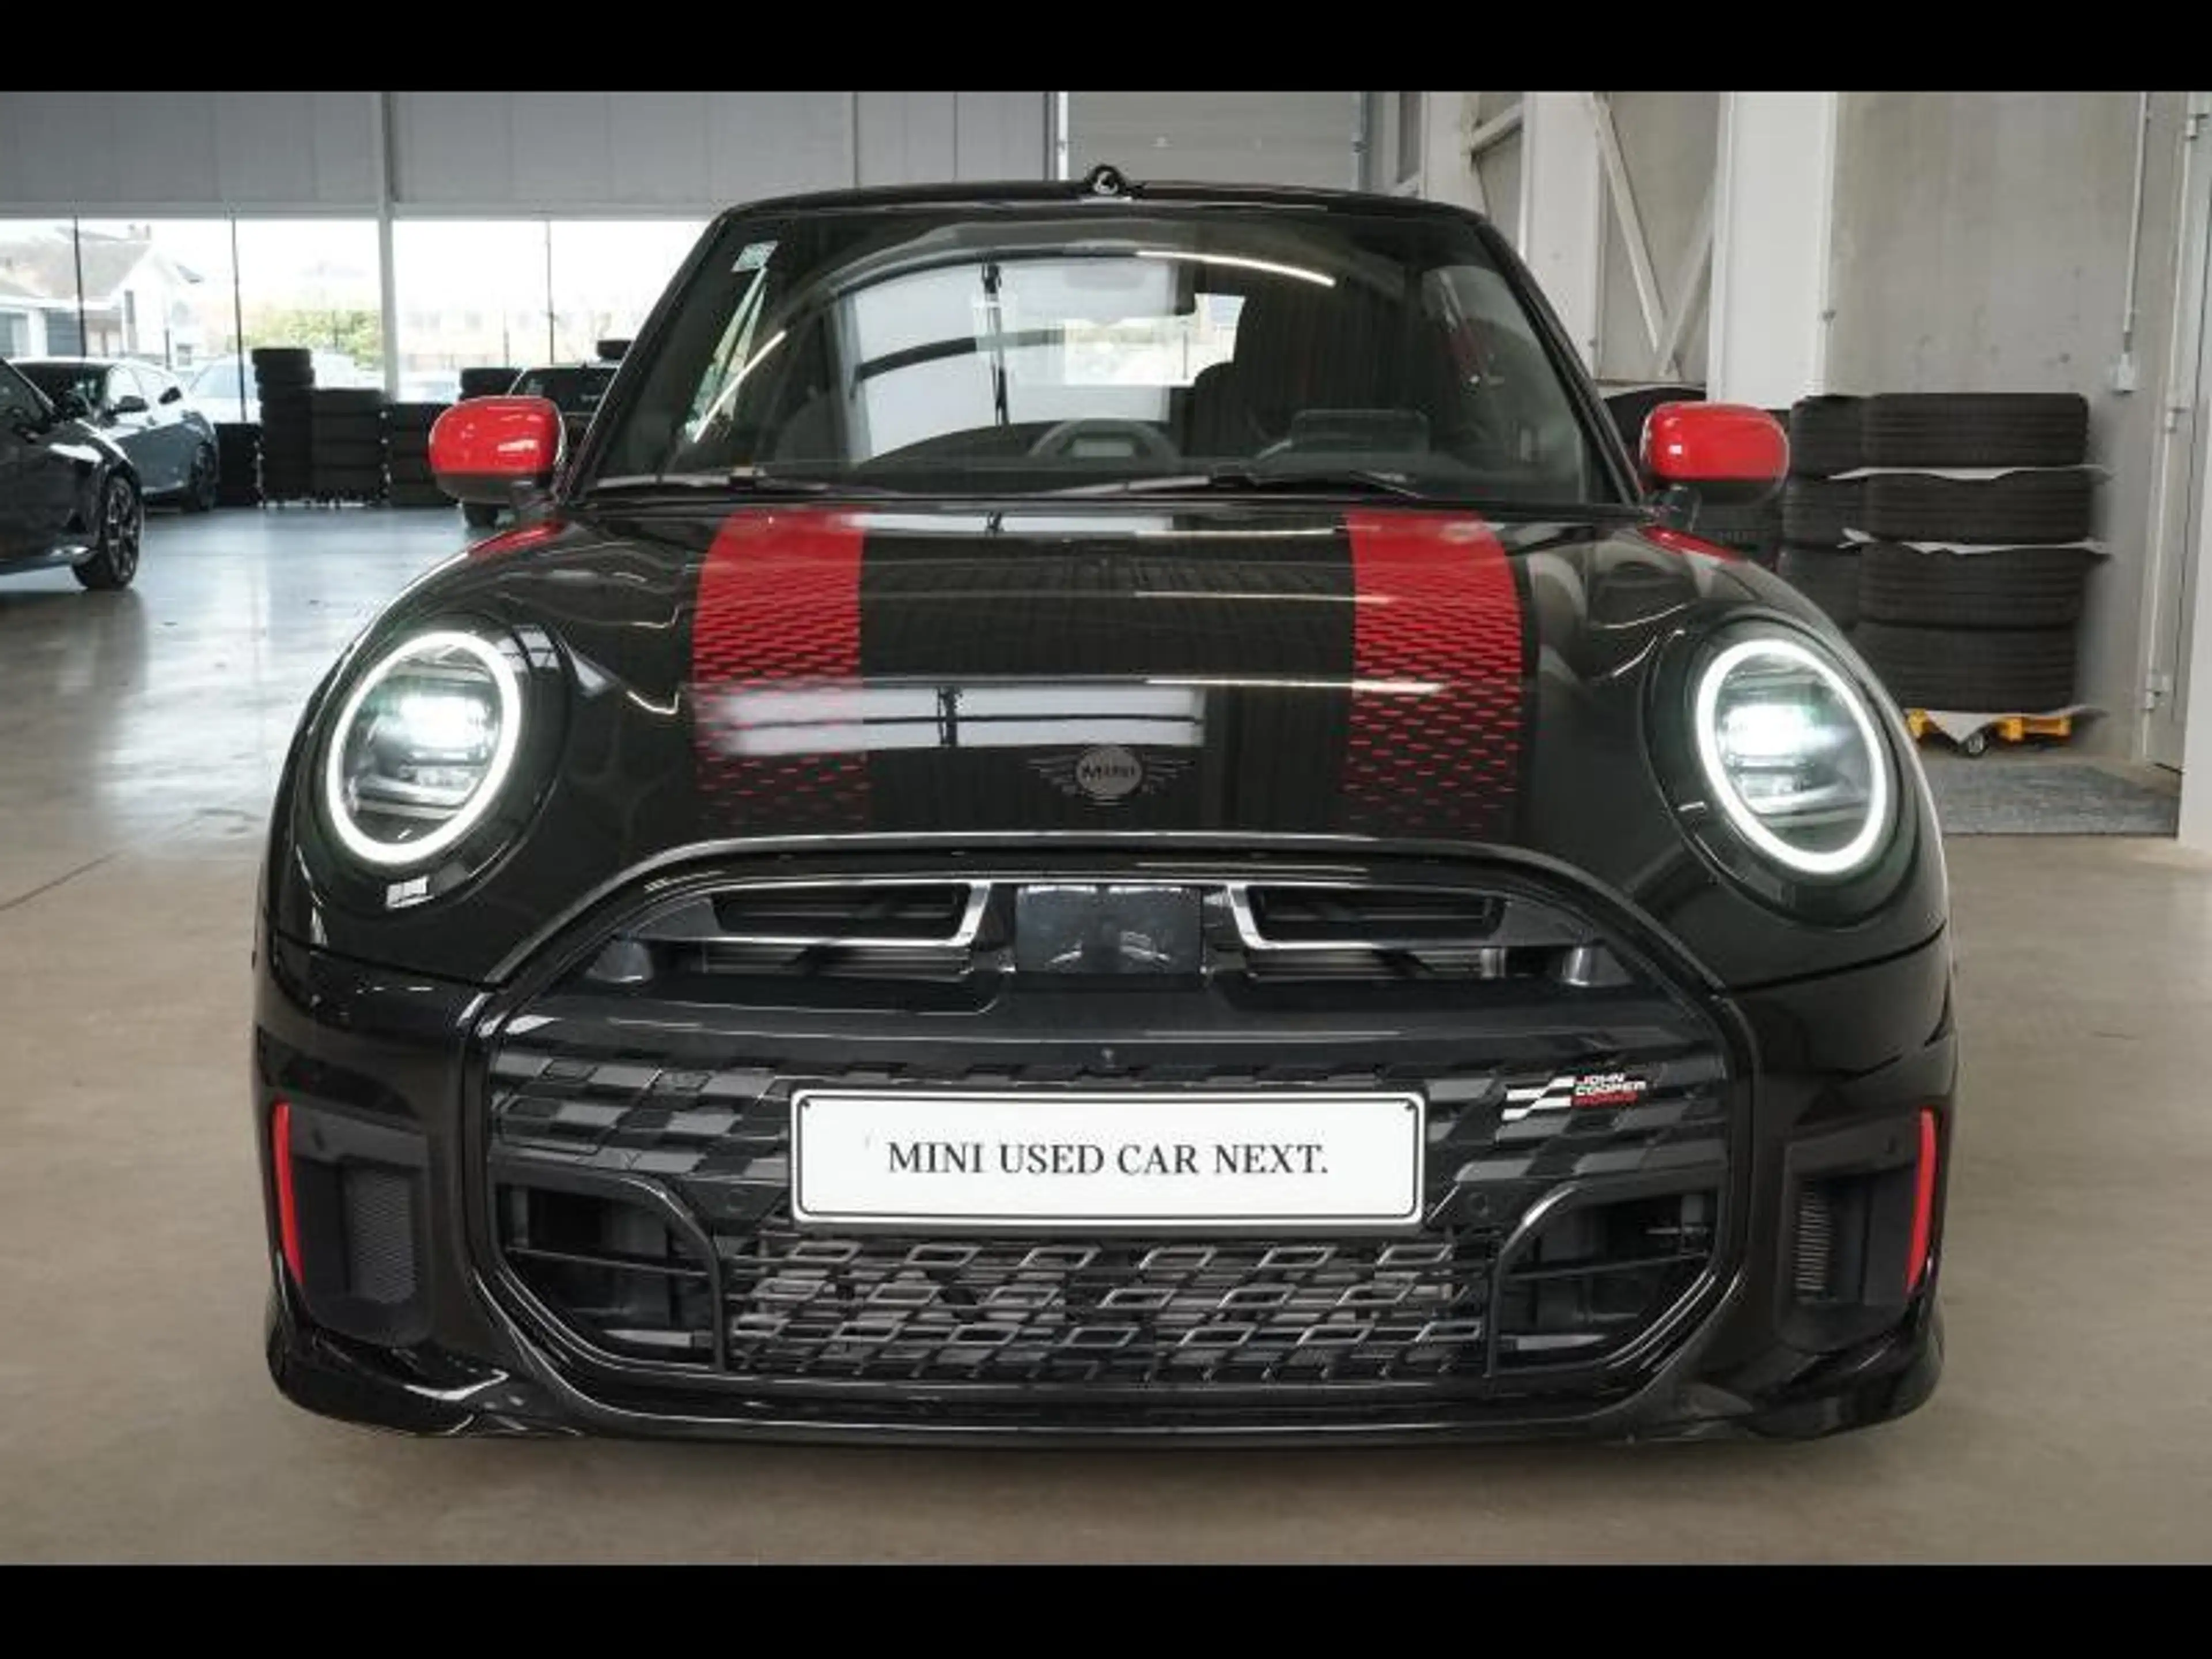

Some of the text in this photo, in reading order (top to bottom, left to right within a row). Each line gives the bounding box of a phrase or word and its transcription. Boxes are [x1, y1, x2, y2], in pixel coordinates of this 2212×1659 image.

[1576, 1073, 1625, 1085] JOHN
[888, 1141, 1328, 1174] MINI USED CAR NEXT.
